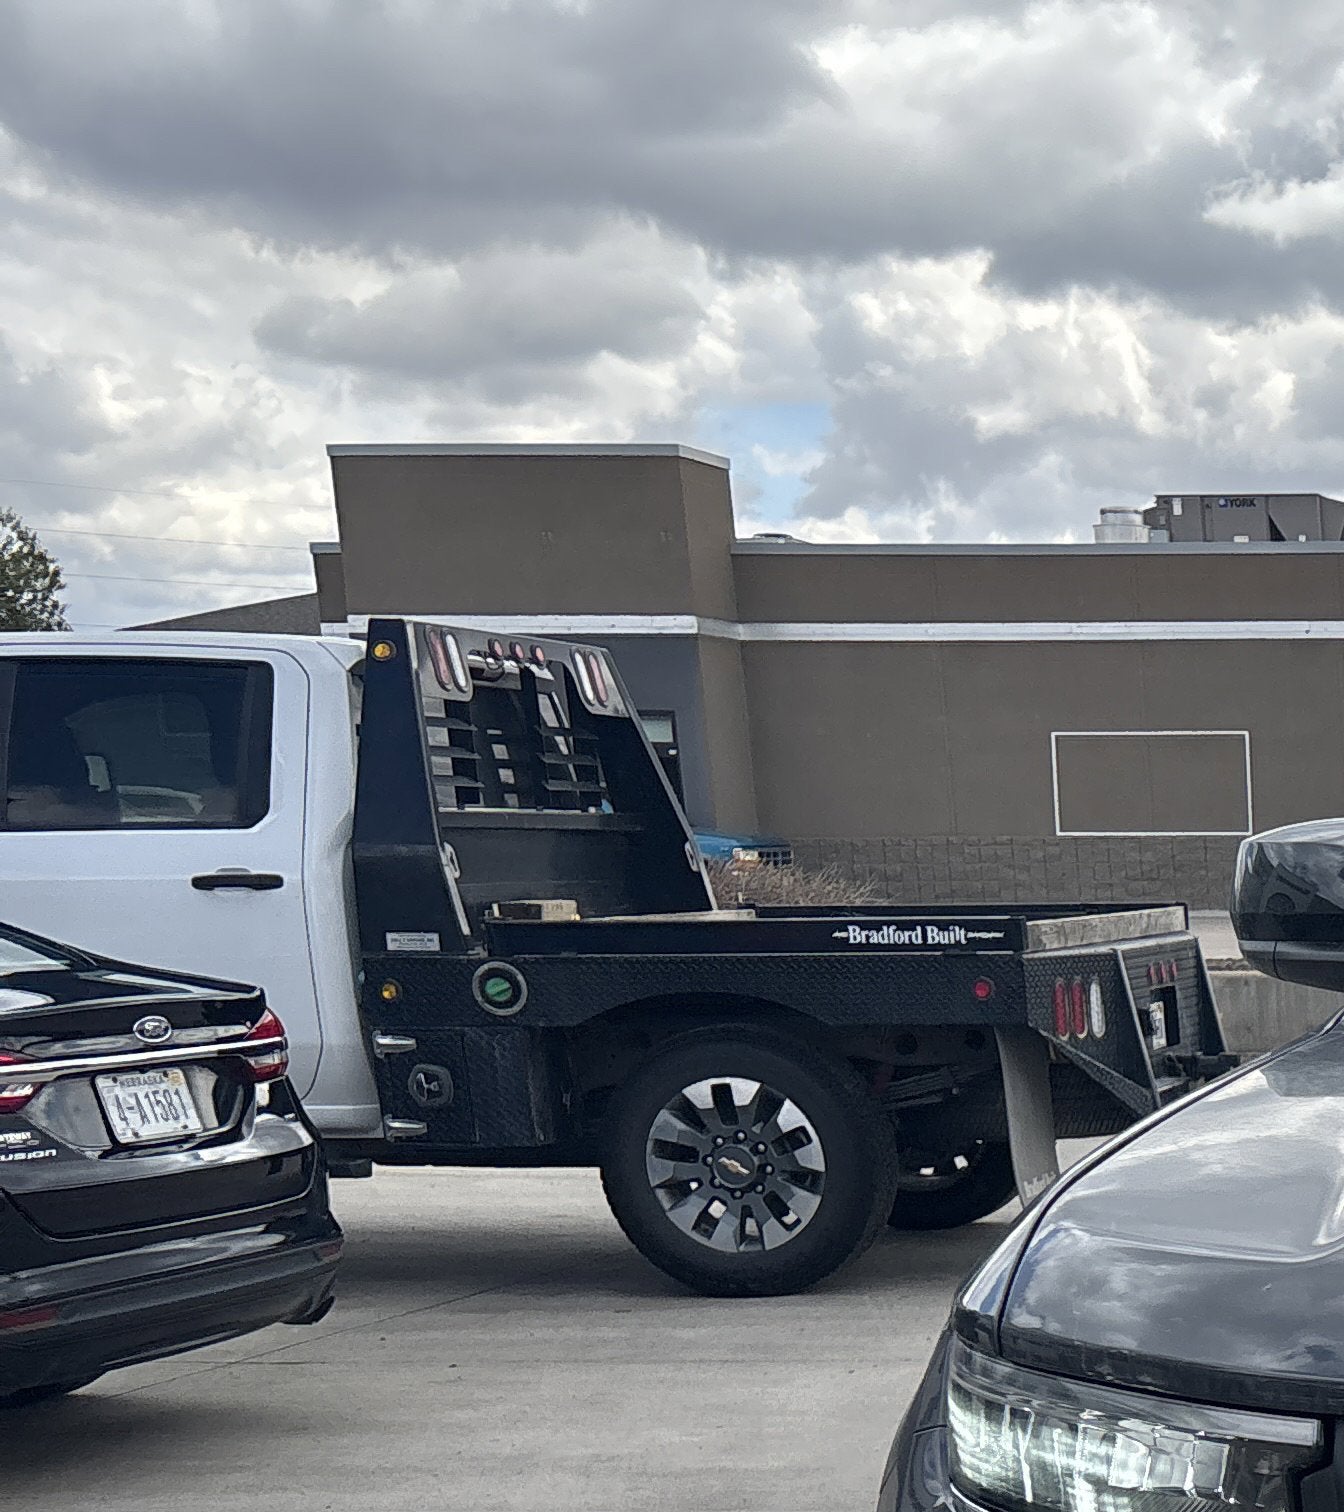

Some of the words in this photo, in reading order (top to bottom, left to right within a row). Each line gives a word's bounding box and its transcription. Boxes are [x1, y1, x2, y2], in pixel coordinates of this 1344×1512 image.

[1229, 498, 1256, 508] YORK
[847, 925, 923, 945] Bradford
[925, 925, 968, 945] Built
